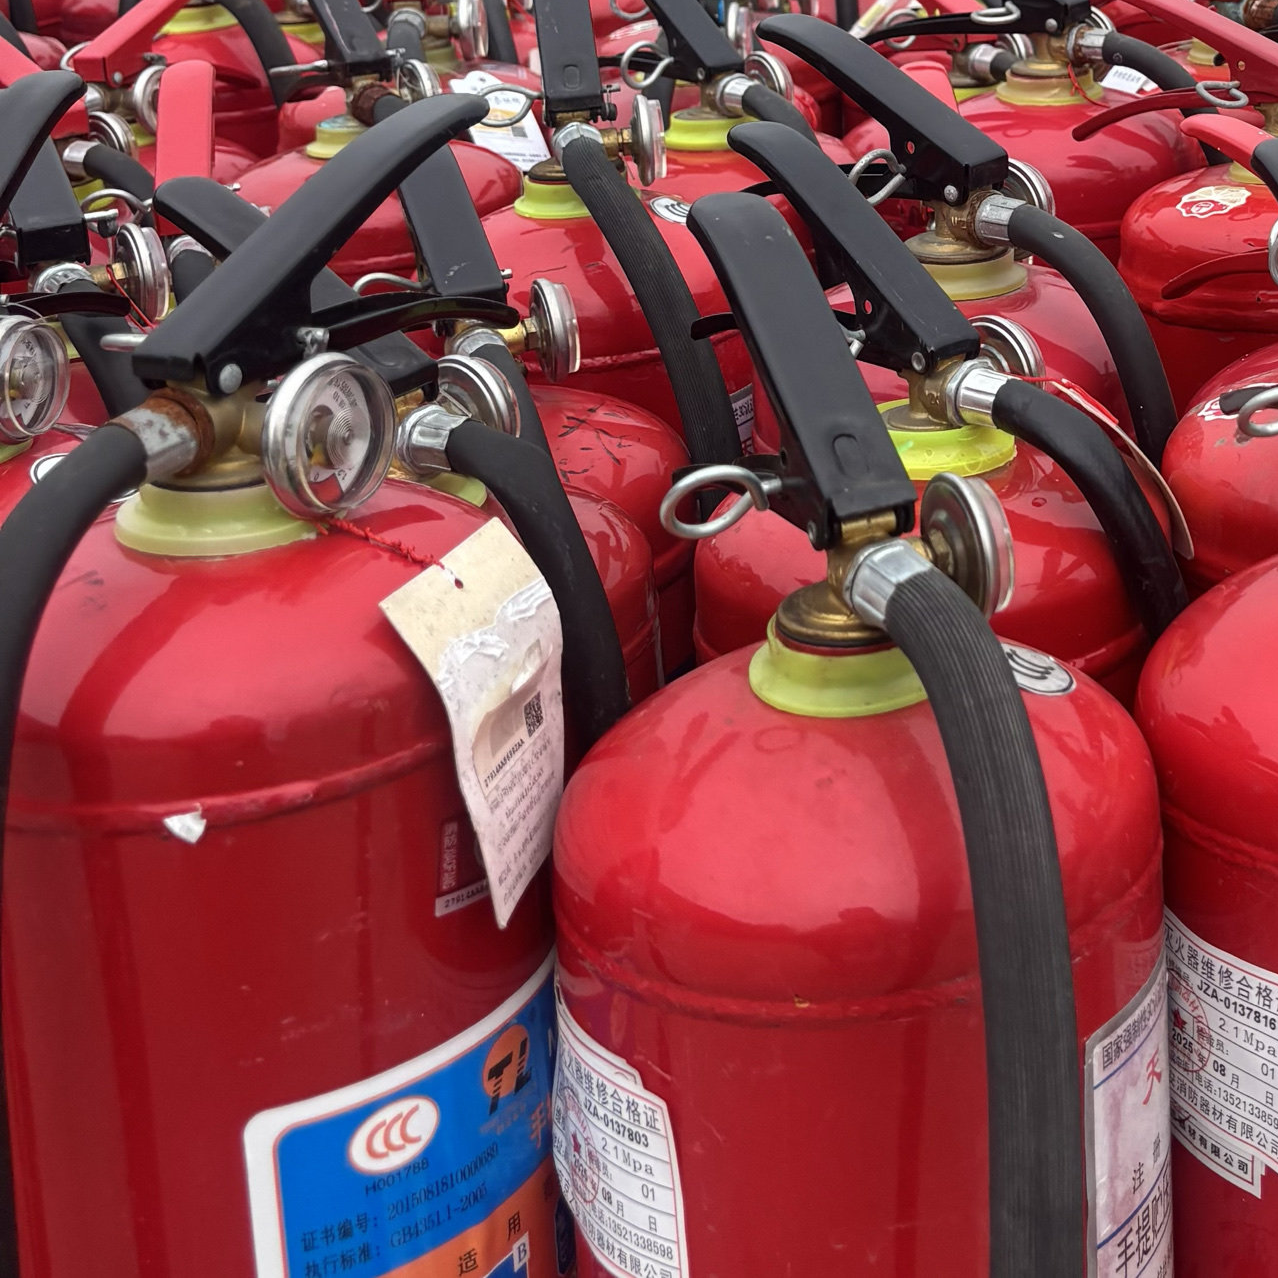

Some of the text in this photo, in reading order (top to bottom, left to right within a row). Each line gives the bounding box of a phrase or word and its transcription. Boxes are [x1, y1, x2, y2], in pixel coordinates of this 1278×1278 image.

[1196, 976, 1277, 1031] JZA-0137816
[1171, 1027, 1194, 1054] 2025
[1212, 1059, 1226, 1077] 08
[1229, 1072, 1240, 1090] 月
[1264, 1091, 1275, 1107] 日
[1260, 1062, 1276, 1080] 01
[583, 1096, 649, 1148] JZA-0137803
[1172, 1113, 1249, 1175] 器材有限公司
[601, 1186, 613, 1205] 08
[616, 1199, 625, 1218] 月
[648, 1214, 658, 1233] 日
[641, 1183, 656, 1202] 01
